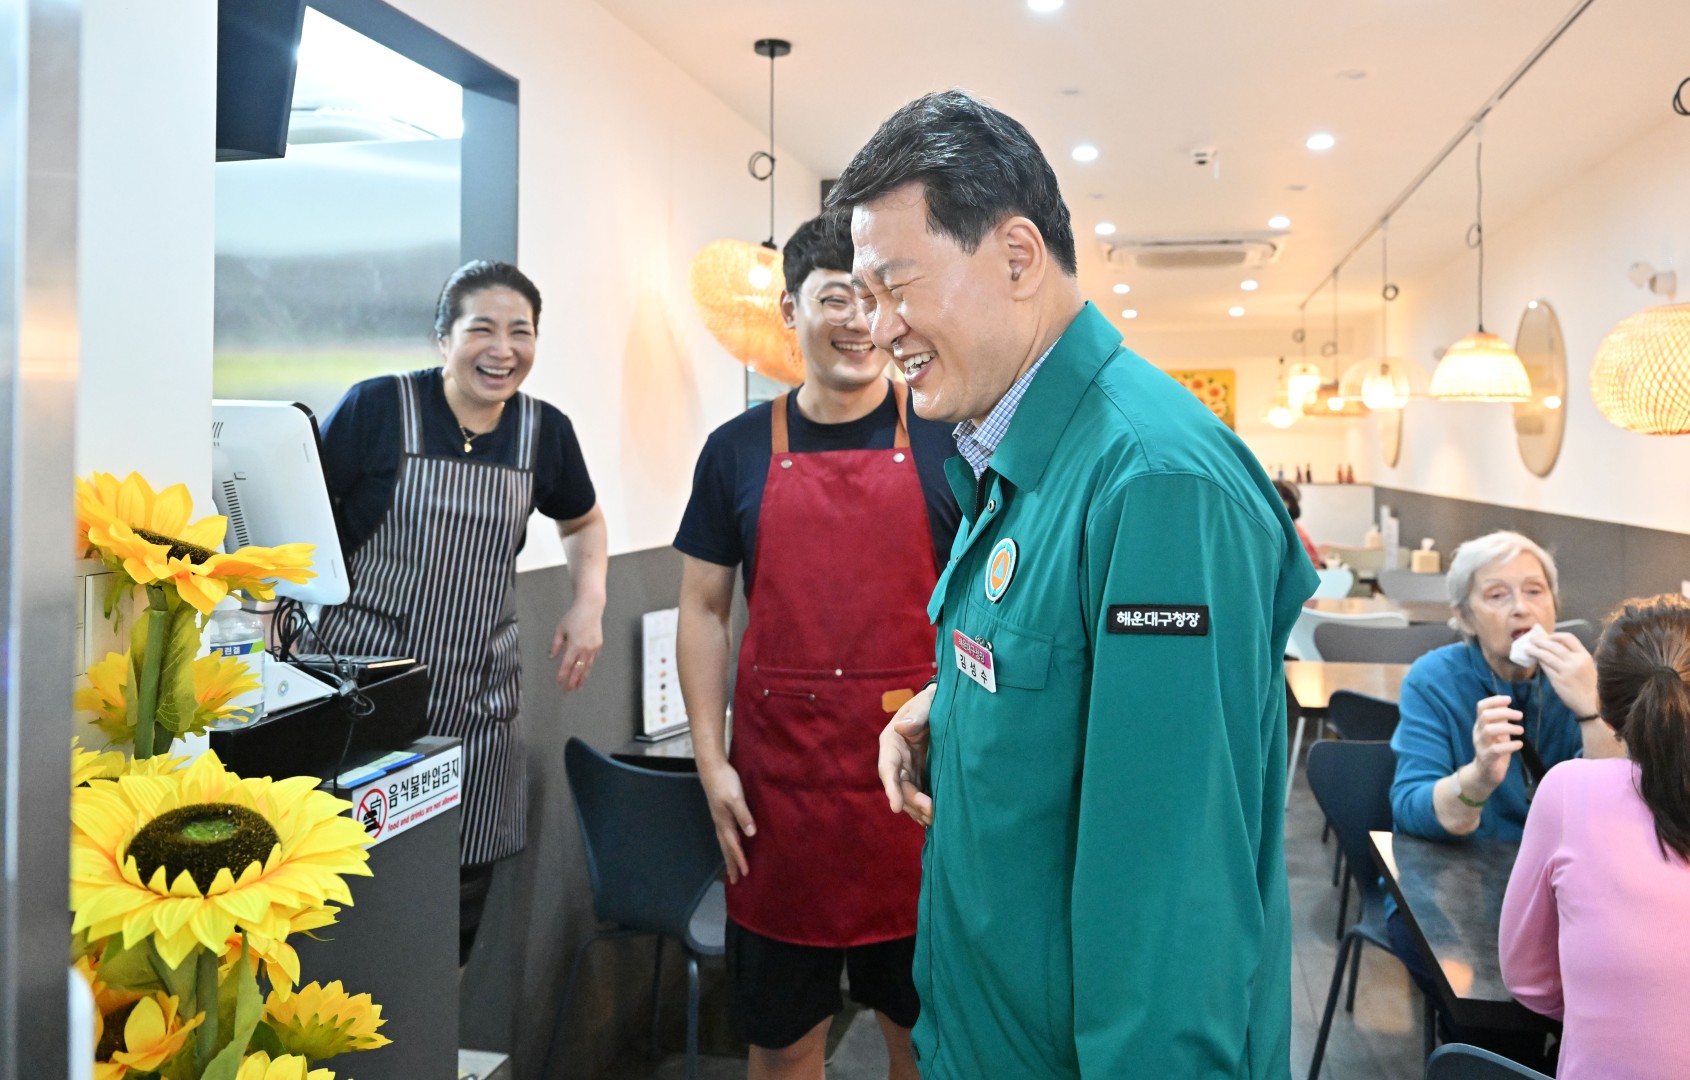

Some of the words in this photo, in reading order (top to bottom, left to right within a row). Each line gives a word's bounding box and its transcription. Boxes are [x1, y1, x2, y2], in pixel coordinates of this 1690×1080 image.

[1116, 610, 1201, 628] 해운대구청장
[960, 653, 987, 684] 김성수
[388, 758, 459, 810] 음식물반입금지
